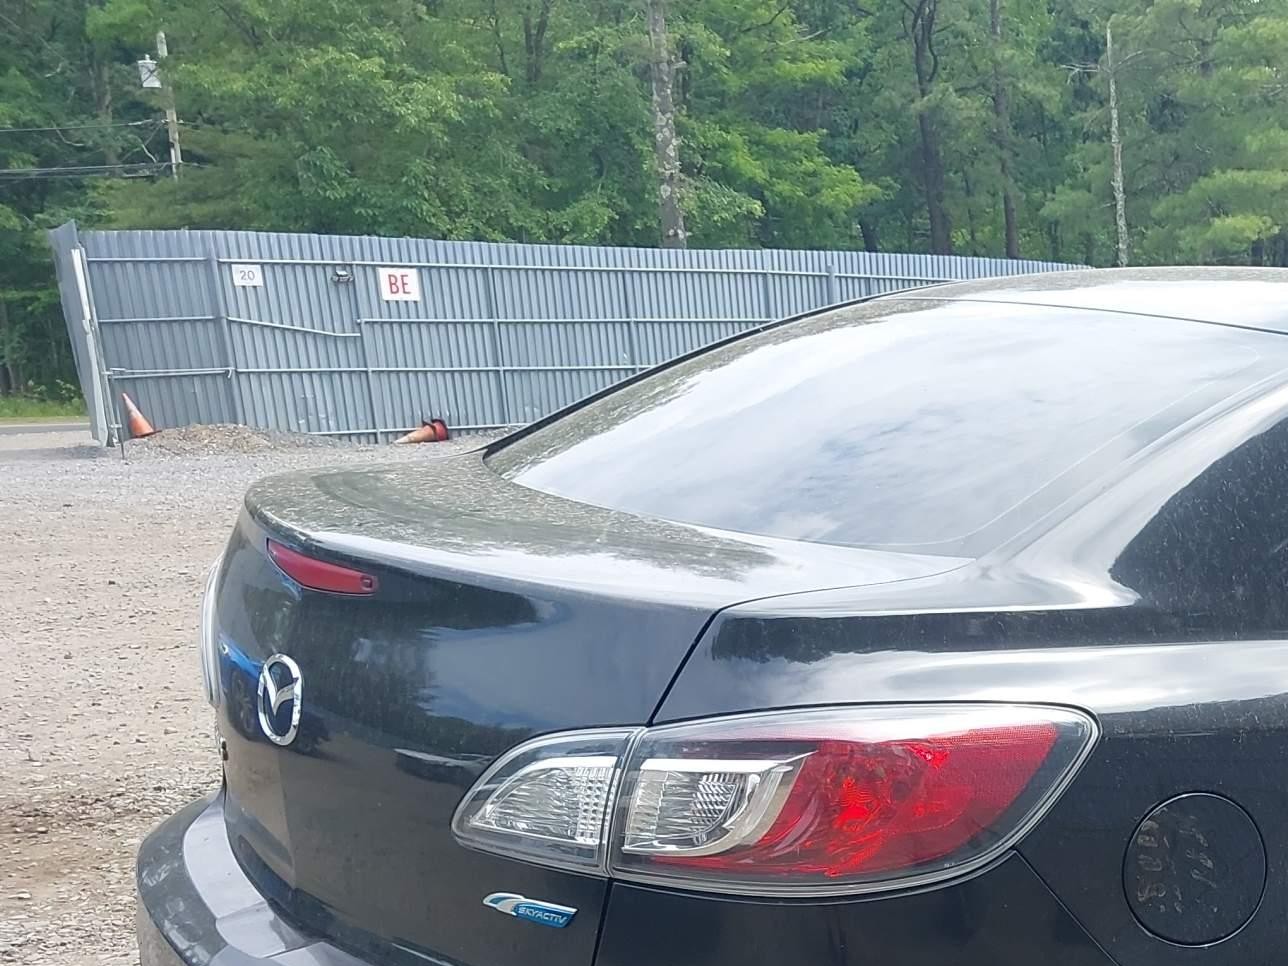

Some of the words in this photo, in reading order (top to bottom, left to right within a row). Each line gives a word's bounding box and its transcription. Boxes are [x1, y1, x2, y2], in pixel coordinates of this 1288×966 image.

[239, 270, 256, 281] 20
[388, 274, 412, 295] BE
[518, 906, 568, 924] SKYACTIV
